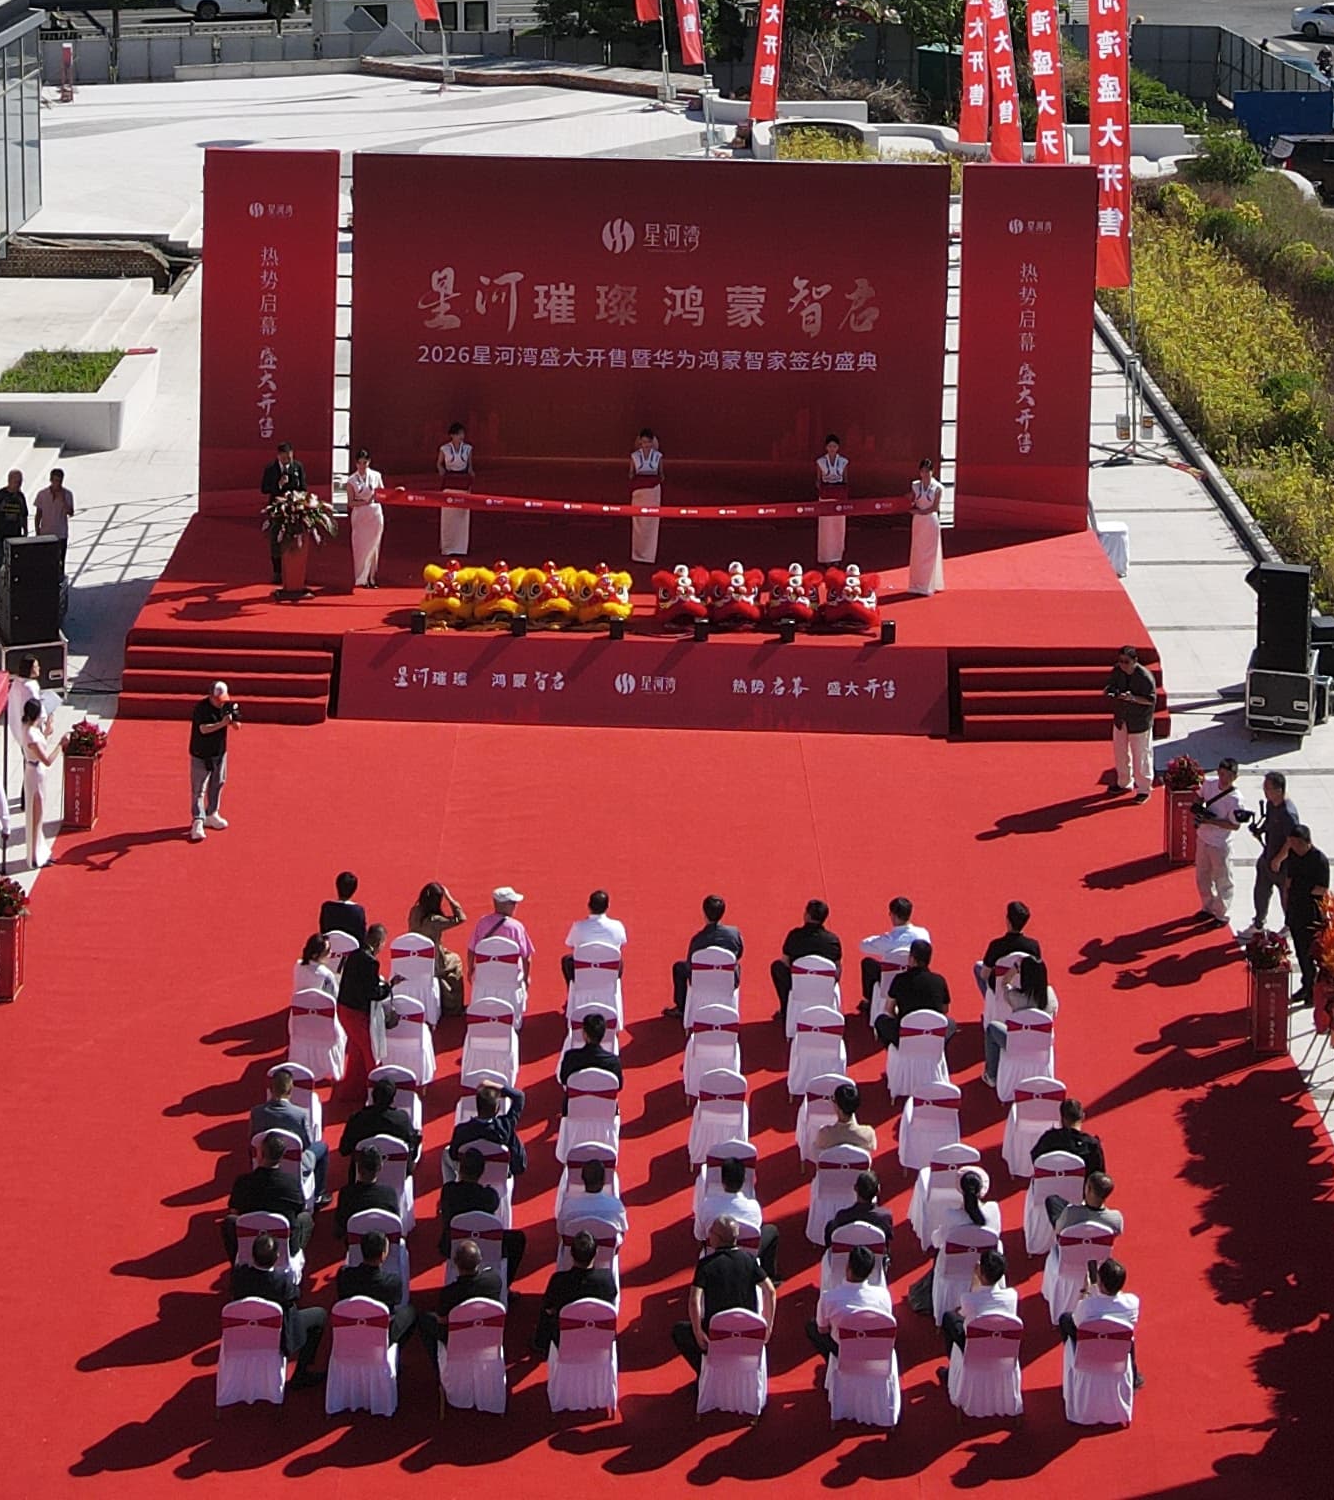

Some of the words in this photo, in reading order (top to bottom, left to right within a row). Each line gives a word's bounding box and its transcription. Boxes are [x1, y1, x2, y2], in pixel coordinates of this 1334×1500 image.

[643, 222, 701, 253] 星河湾
[259, 246, 280, 336] 热势启幕
[416, 266, 882, 339] 星河璀璨鸿蒙智启
[1019, 262, 1039, 352] 热势启幕
[417, 344, 878, 373] 2026星河湾盛大开售暨华为鸿蒙智家签约盛典
